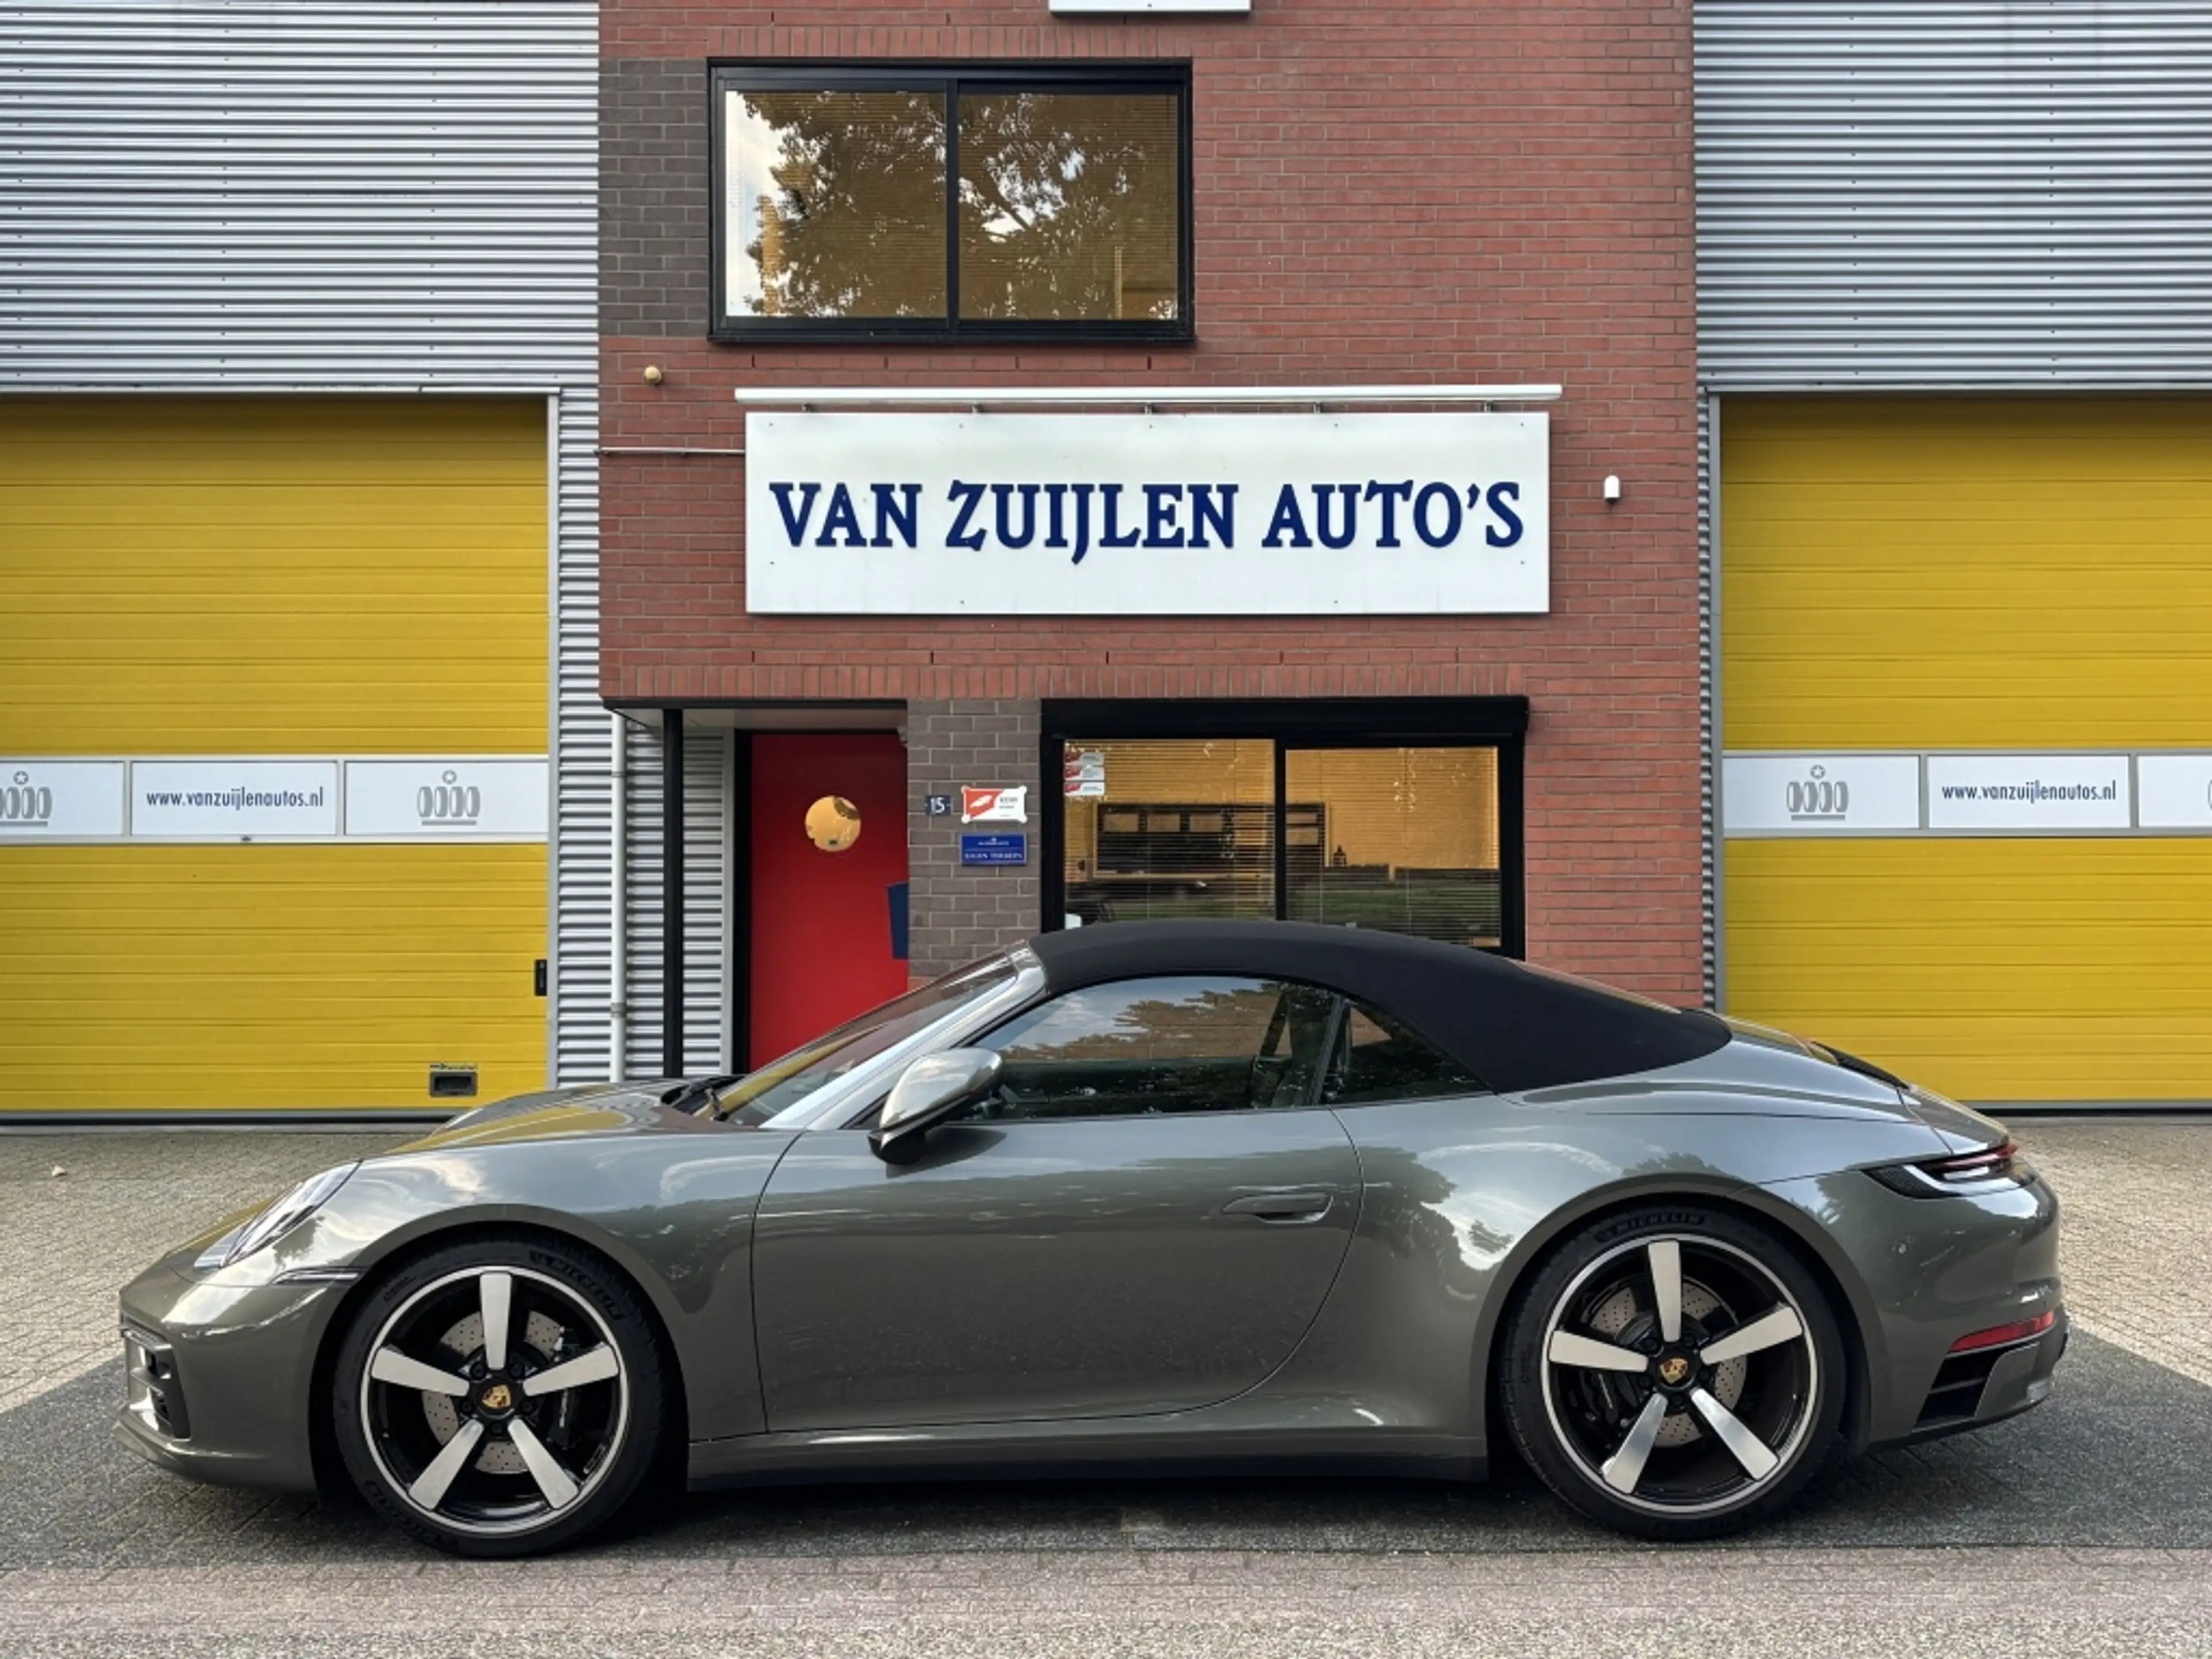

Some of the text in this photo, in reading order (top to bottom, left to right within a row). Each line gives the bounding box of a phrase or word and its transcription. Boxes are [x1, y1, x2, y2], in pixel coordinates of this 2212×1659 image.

[768, 480, 1523, 565] VAN ZUIJLEN AUTO'S
[146, 786, 324, 810] www.vanzuijlenautos.nl
[1941, 779, 2116, 804] www.vanzuijlenautos.nl
[930, 797, 945, 813] 15
